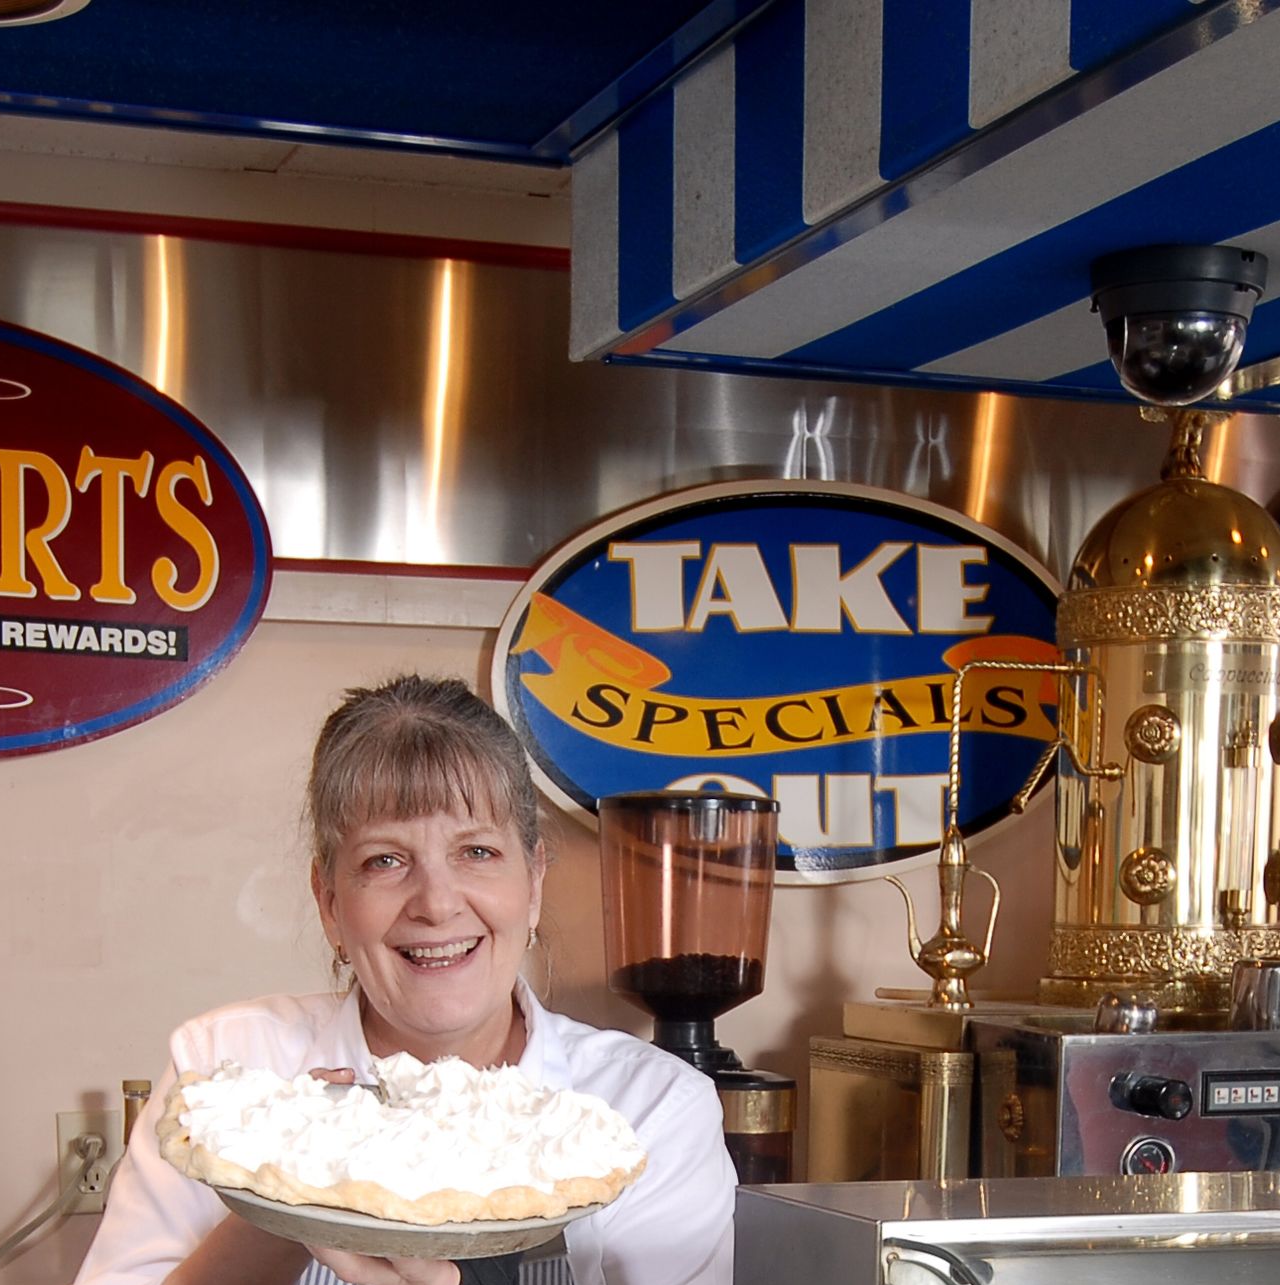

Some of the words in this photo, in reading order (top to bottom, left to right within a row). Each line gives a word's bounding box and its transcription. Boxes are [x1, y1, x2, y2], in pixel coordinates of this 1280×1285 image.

[607, 540, 997, 636] TAKE
[1, 620, 178, 657] REWARDS!
[570, 681, 1030, 752] SPECIALS
